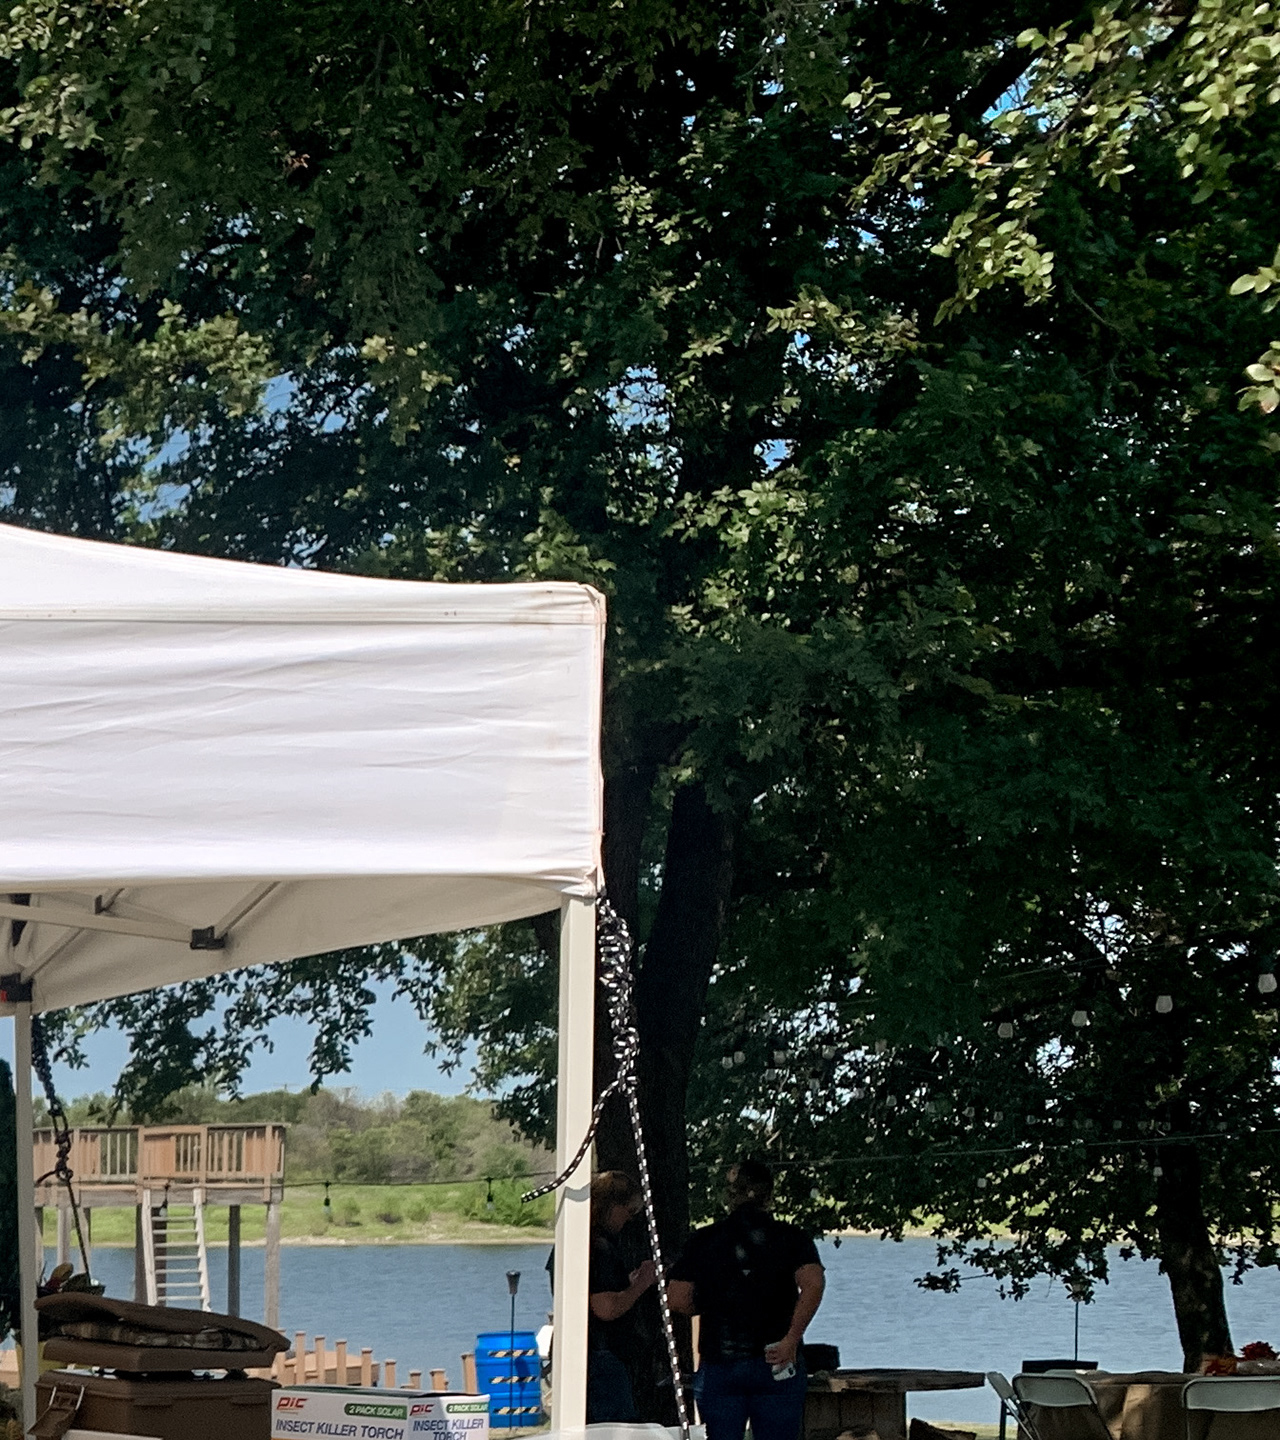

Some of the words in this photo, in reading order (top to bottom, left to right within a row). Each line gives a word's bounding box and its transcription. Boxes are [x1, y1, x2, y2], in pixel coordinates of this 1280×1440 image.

[356, 1406, 375, 1415] PACK
[376, 1408, 404, 1417] SOLAR
[276, 1419, 315, 1433] INSECT
[316, 1423, 357, 1437] KILLER
[361, 1426, 404, 1440] TORCH
[413, 1420, 449, 1431] INSECT
[451, 1419, 484, 1429] KILLER
